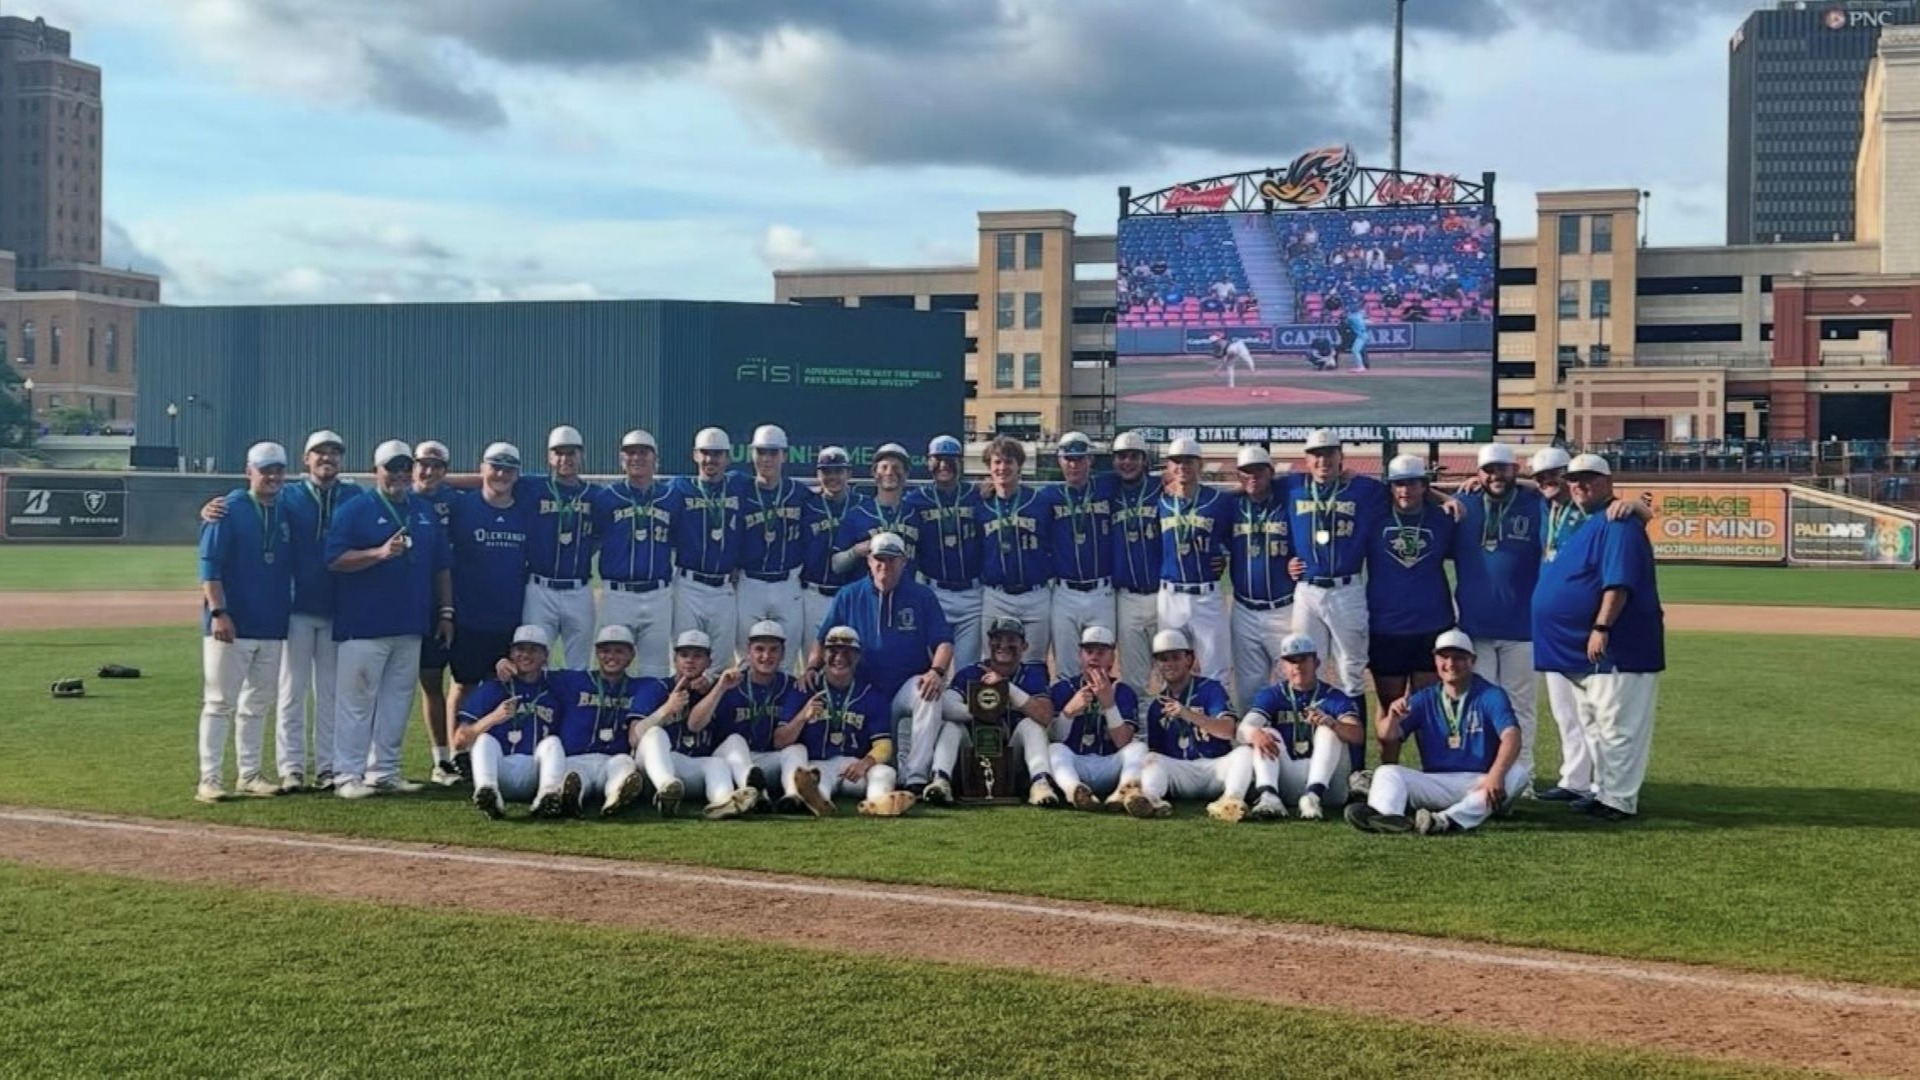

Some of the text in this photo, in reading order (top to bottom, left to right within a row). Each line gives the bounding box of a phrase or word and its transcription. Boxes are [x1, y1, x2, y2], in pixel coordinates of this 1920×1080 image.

[1850, 11, 1893, 27] PNC
[1199, 427, 1237, 440] STATE
[1239, 428, 1268, 440] HIGH
[1271, 427, 1316, 440] SCHOO
[1331, 427, 1383, 440] ASEBALL
[1387, 427, 1474, 440] TOURNAMENT
[1663, 496, 1751, 517] PEACE
[1664, 519, 1776, 538] OF MIND
